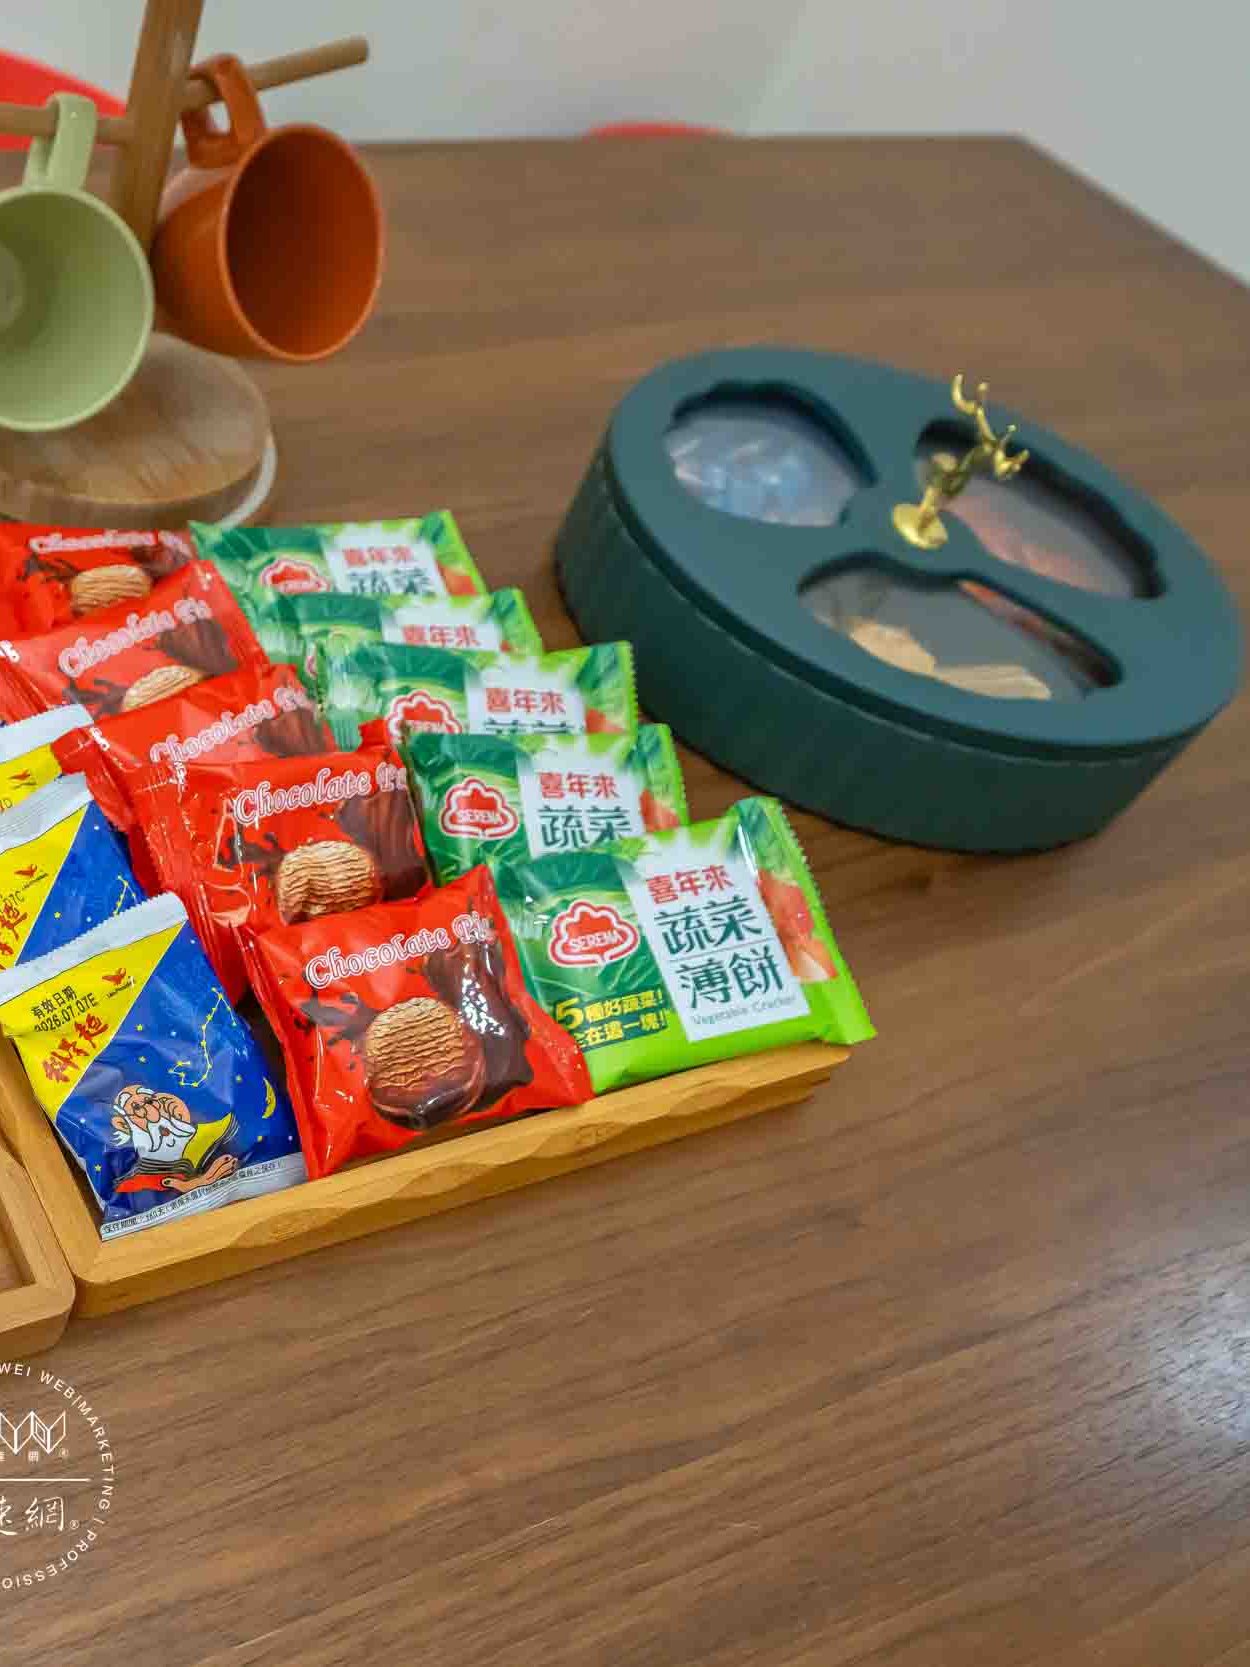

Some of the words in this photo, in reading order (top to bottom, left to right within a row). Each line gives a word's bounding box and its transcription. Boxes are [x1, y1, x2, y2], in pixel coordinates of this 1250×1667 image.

[485, 687, 567, 715] 喜年來
[234, 767, 372, 826] Chocolate
[536, 771, 621, 800] 喜年來
[537, 805, 632, 850] 蔬菜
[646, 864, 735, 905] 喜年來
[654, 895, 764, 955] 蔬菜
[305, 926, 451, 990] Chocolate
[675, 945, 785, 1010] 薄餅
[31, 985, 78, 1020] 有效日期
